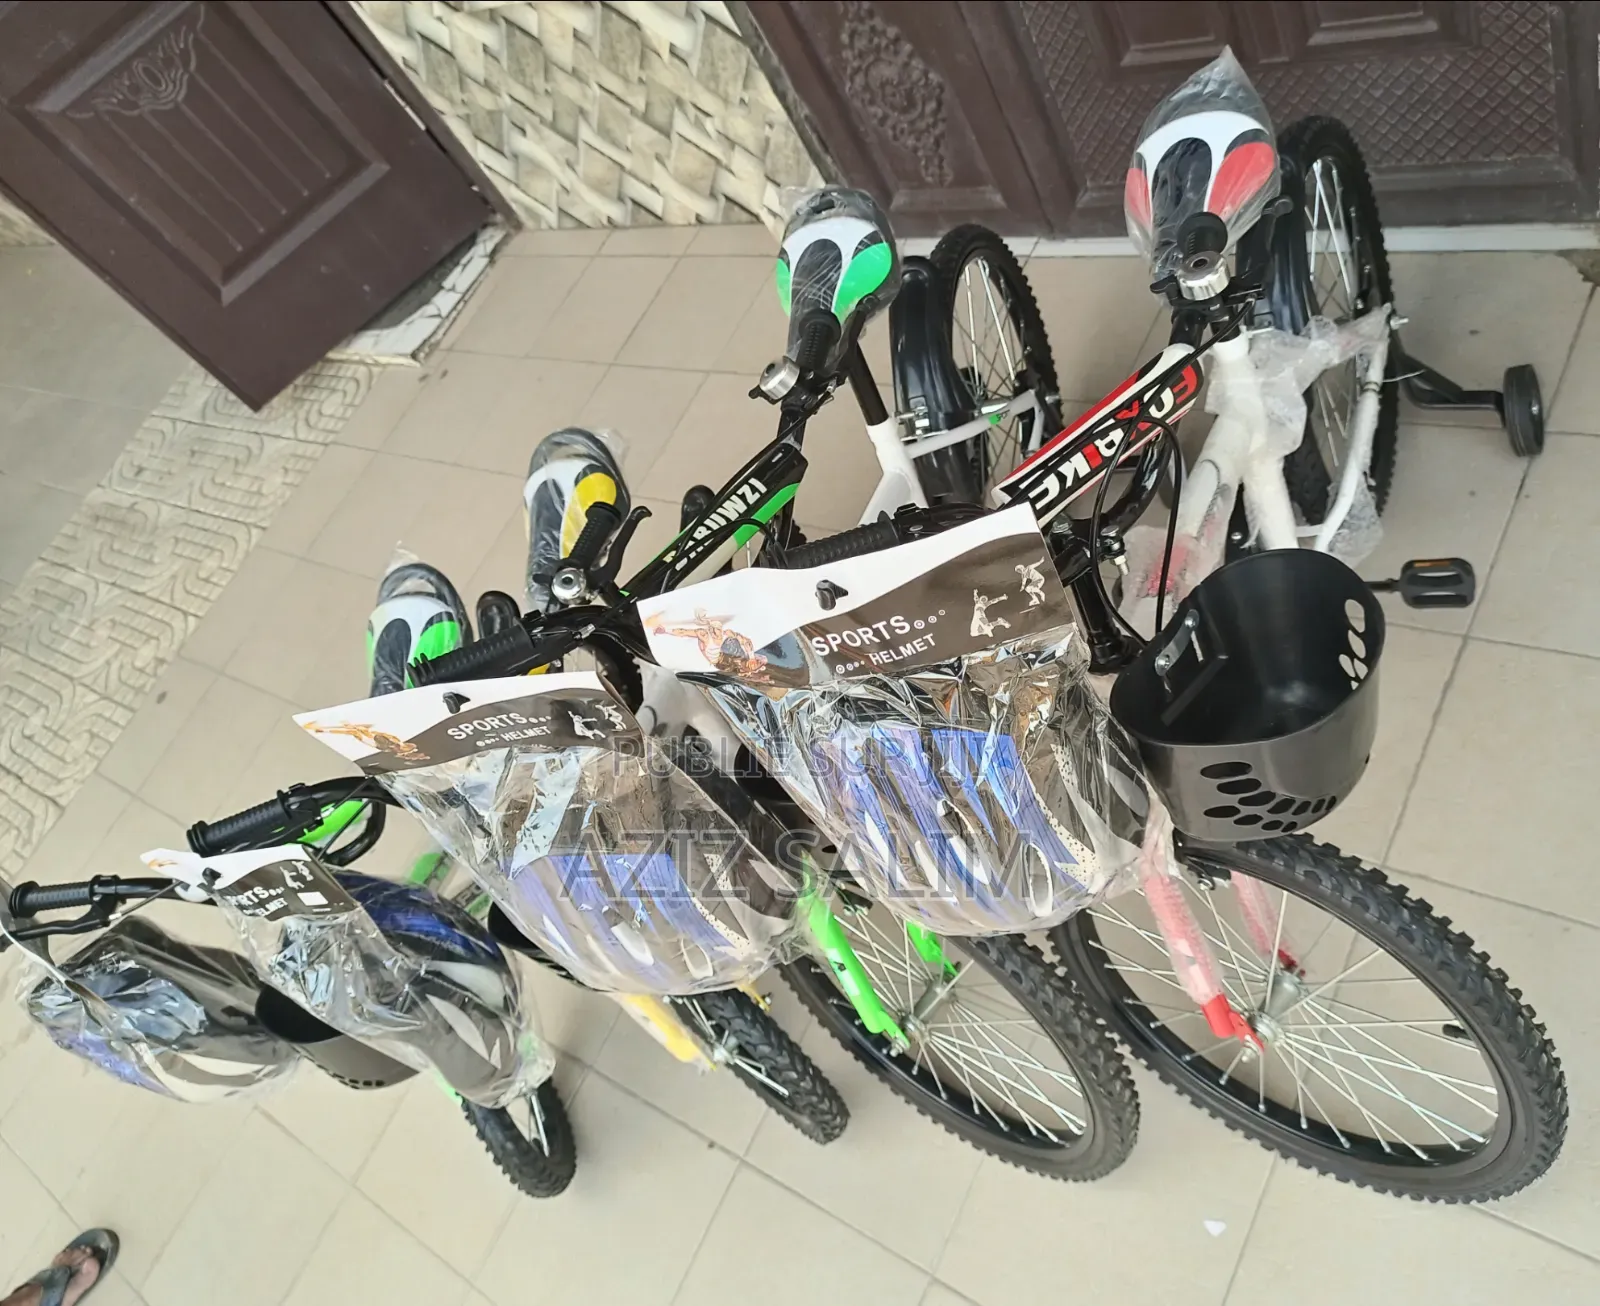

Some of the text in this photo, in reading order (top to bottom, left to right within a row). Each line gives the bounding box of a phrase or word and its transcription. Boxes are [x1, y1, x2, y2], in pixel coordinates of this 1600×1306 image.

[1020, 365, 1198, 510] FOXBIKE
[810, 614, 912, 657] SPORTS
[870, 632, 937, 666] HELMET
[447, 712, 527, 740] SPORTS
[501, 725, 551, 743] HELMET
